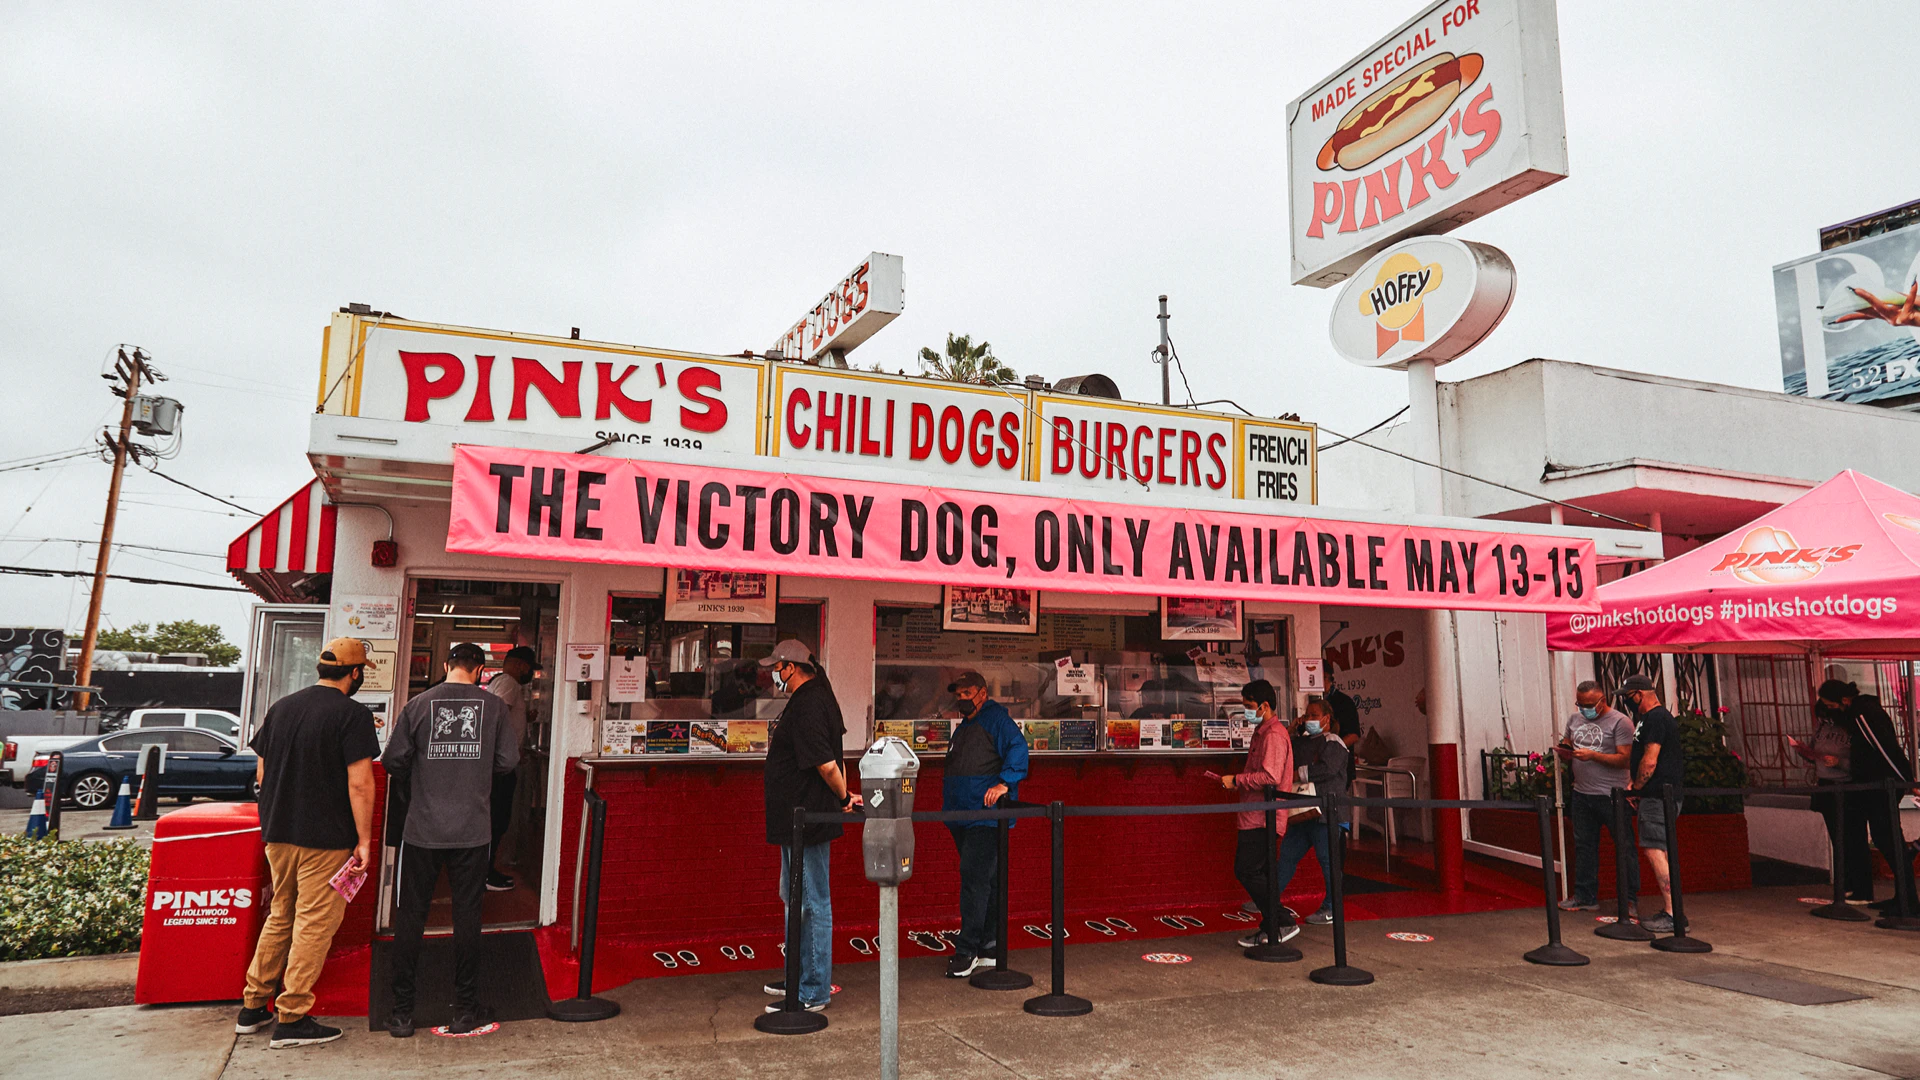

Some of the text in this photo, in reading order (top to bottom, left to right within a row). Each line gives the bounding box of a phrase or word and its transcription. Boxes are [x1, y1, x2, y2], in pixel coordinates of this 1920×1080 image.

[1311, 0, 1480, 122] MADE SPECIAL FOR
[1306, 82, 1502, 239] PINK'S
[1370, 269, 1430, 316] HOFFY
[1885, 356, 1920, 383] FX
[398, 350, 728, 433] PINK'S
[786, 386, 1021, 470] CHILI DOGS
[1051, 416, 1227, 490] BURGERS
[1249, 432, 1308, 466] FRENCH
[1257, 469, 1298, 500] FRIES
[489, 462, 1583, 599] THE VICTORY DOG, ONLY AVAILABLE MAY 13-15
[1709, 543, 1863, 572] PINK'S
[698, 604, 745, 613] PINK'S 1939
[1569, 593, 1897, 635] @pinkshotdogs #pinkshotdogs
[1325, 630, 1405, 672] NK'S
[1347, 679, 1366, 690] 1939
[430, 744, 480, 753] FIRESTONE WALKER
[152, 888, 252, 910] PINK'S
[174, 908, 229, 917] A HOLLYWOOD
[163, 917, 237, 926] LEGEND SINCE 1939
